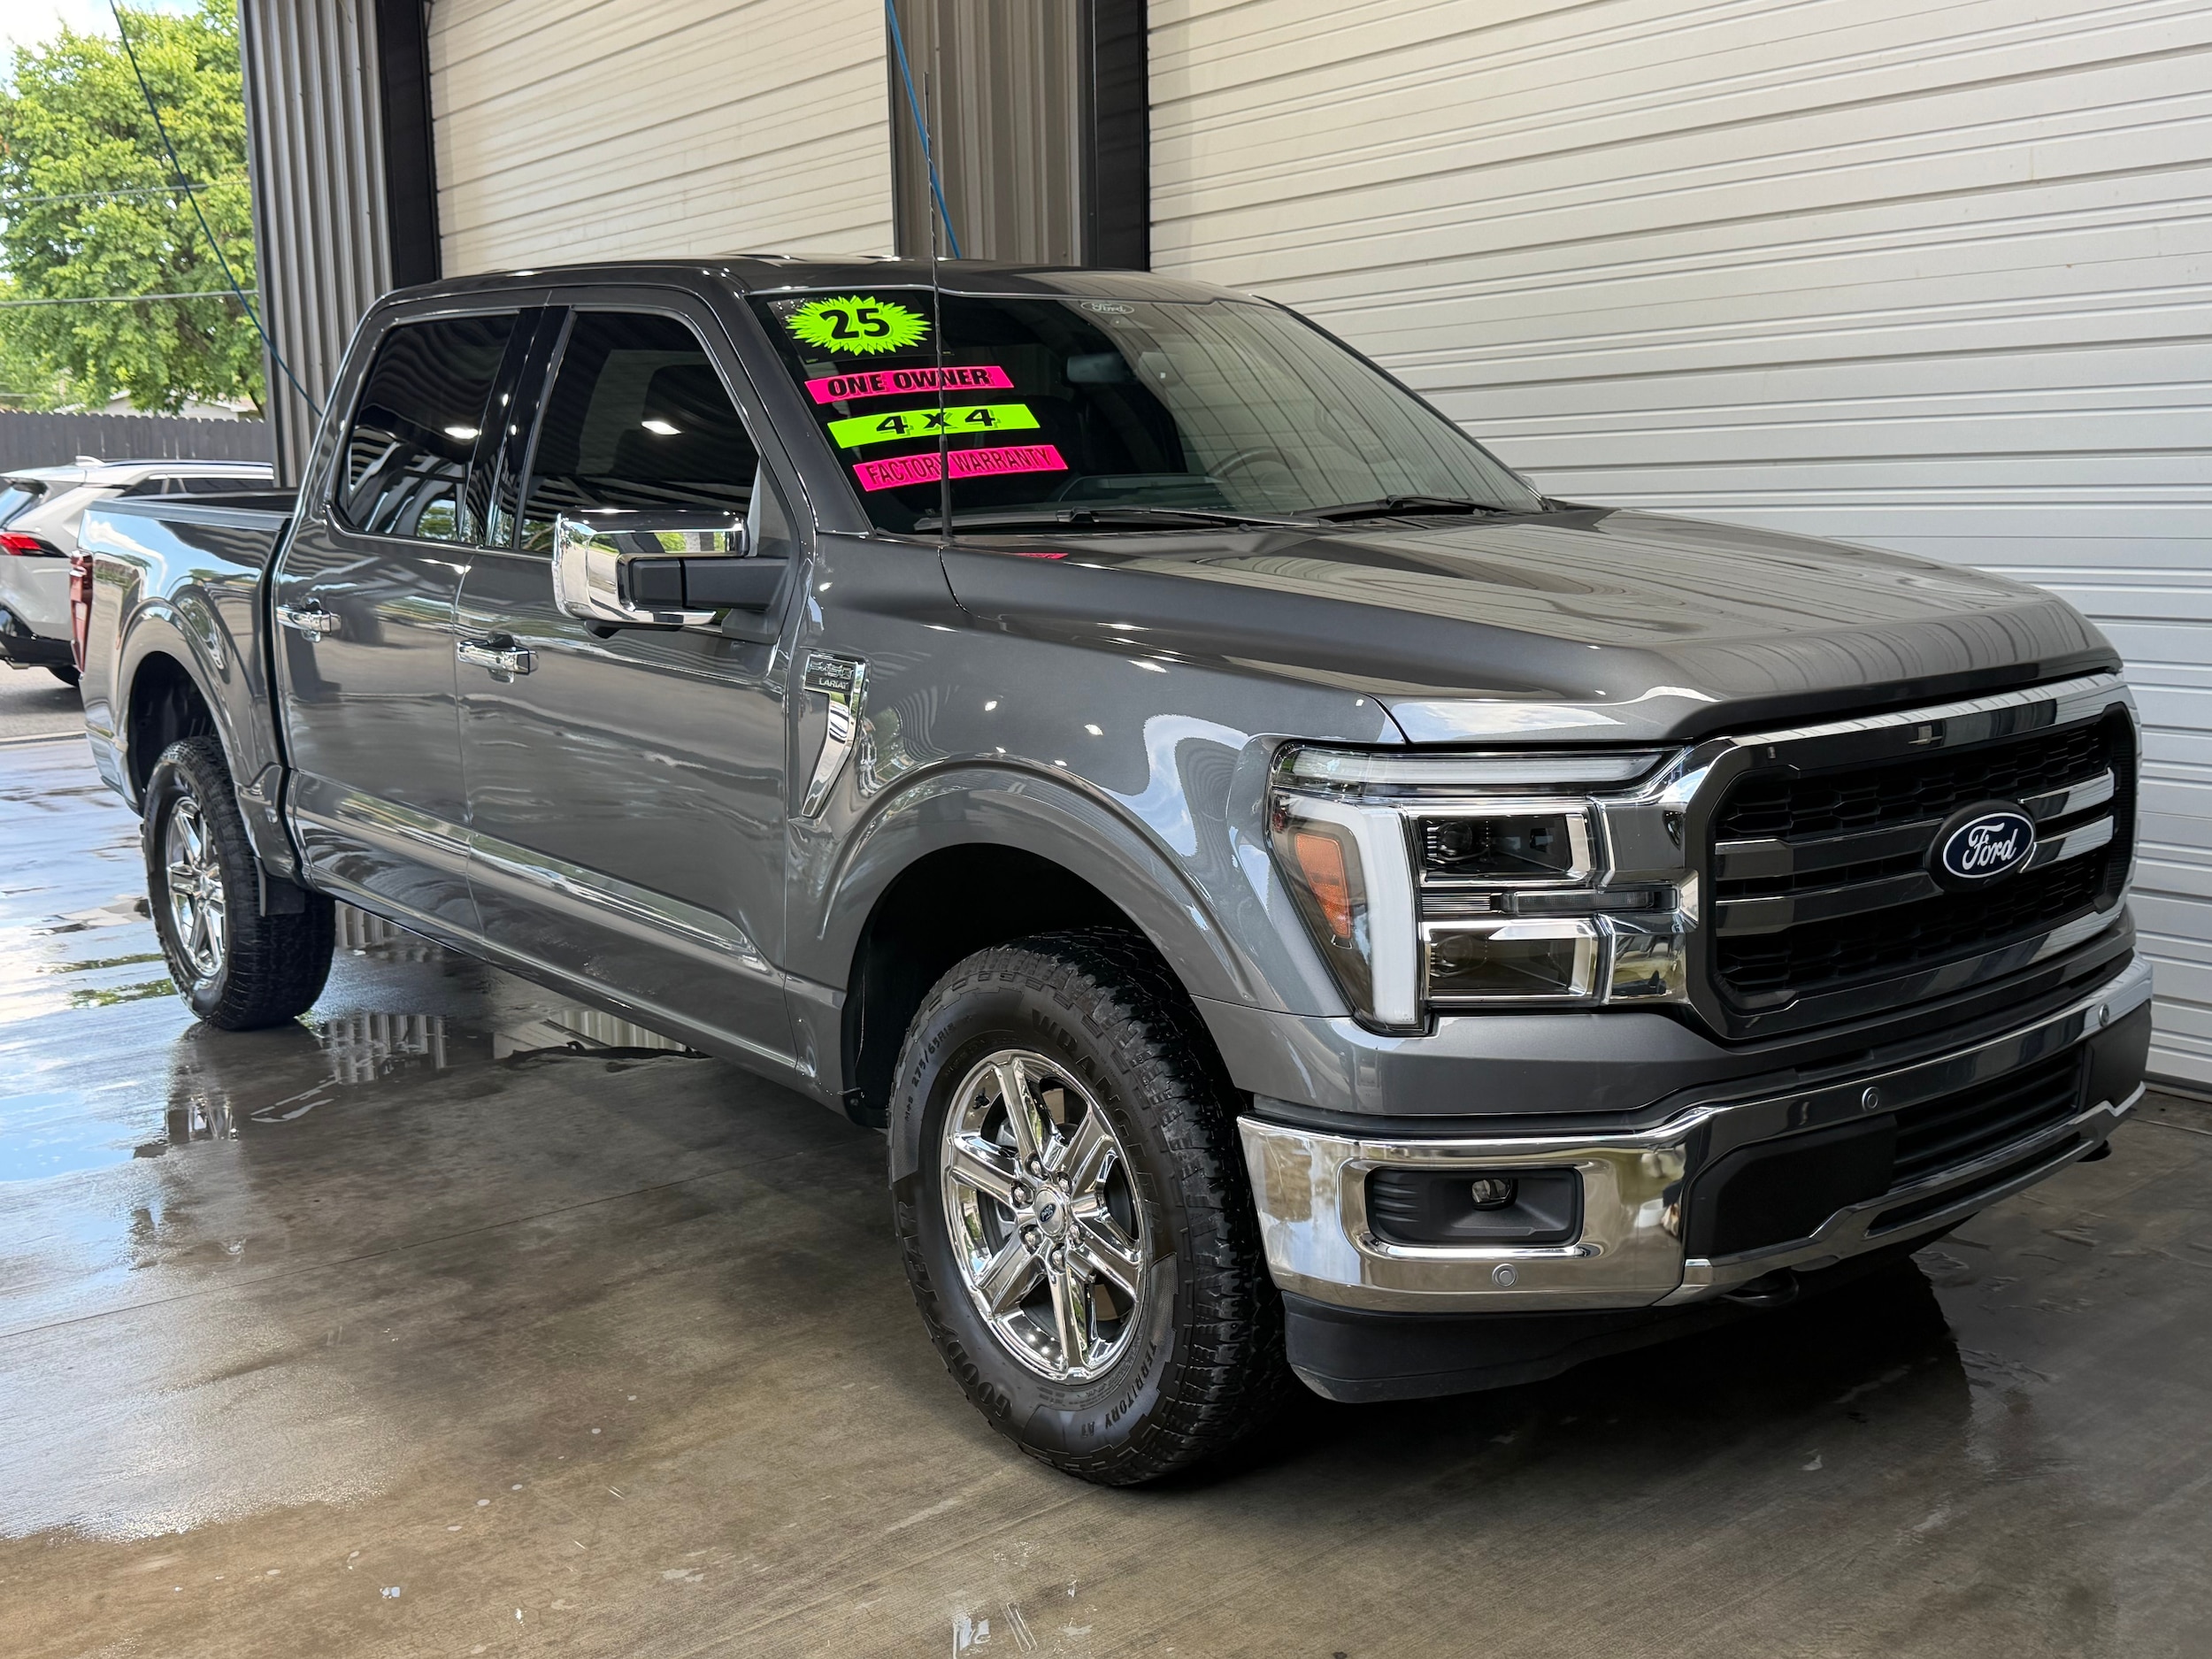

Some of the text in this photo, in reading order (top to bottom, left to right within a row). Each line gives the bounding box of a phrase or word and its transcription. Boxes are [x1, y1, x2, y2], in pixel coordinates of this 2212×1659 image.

[819, 307, 891, 340] 25
[827, 368, 992, 397] ONE OWNER
[876, 415, 910, 434] 4
[964, 408, 996, 426] 4
[950, 448, 1052, 472] WARRANTY
[818, 677, 849, 690] LARIAT
[1962, 822, 2019, 871] Ford
[898, 1201, 1012, 1423] GOODYEAR
[1104, 1340, 1158, 1430] TERRITORY
